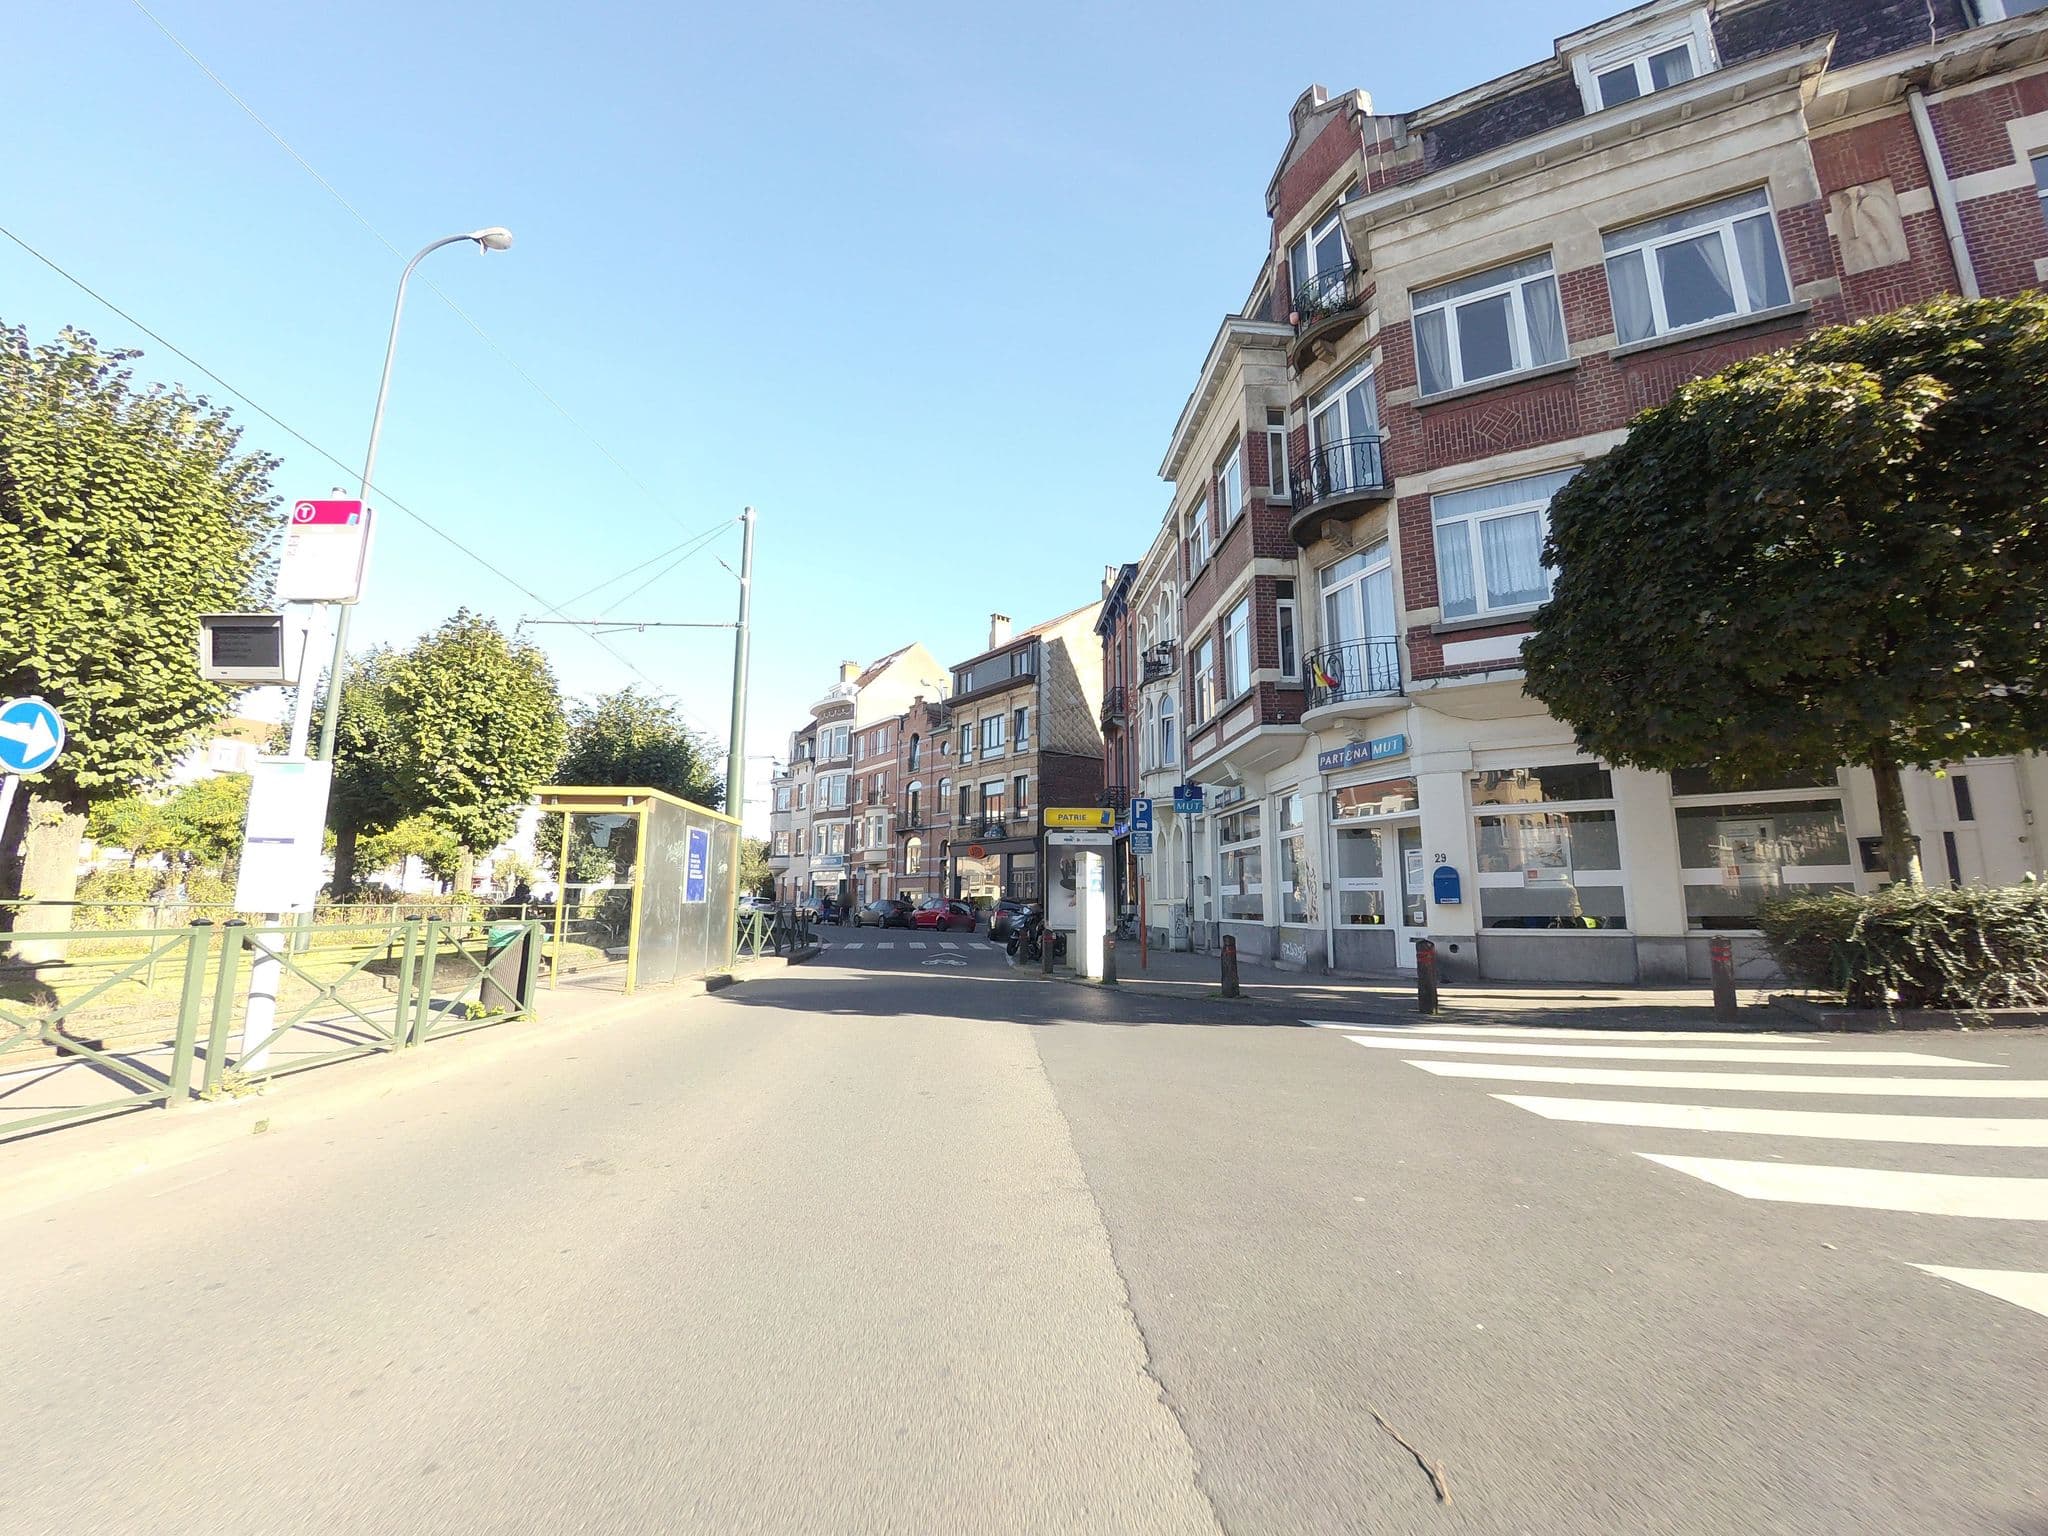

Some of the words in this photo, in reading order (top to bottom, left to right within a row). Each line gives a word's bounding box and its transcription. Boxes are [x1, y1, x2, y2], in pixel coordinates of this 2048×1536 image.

[1373, 739, 1399, 755] MUT
[1135, 800, 1148, 819] P
[1176, 802, 1201, 811] MUT
[1057, 813, 1088, 821] PATRIE
[1434, 853, 1447, 863] 29
